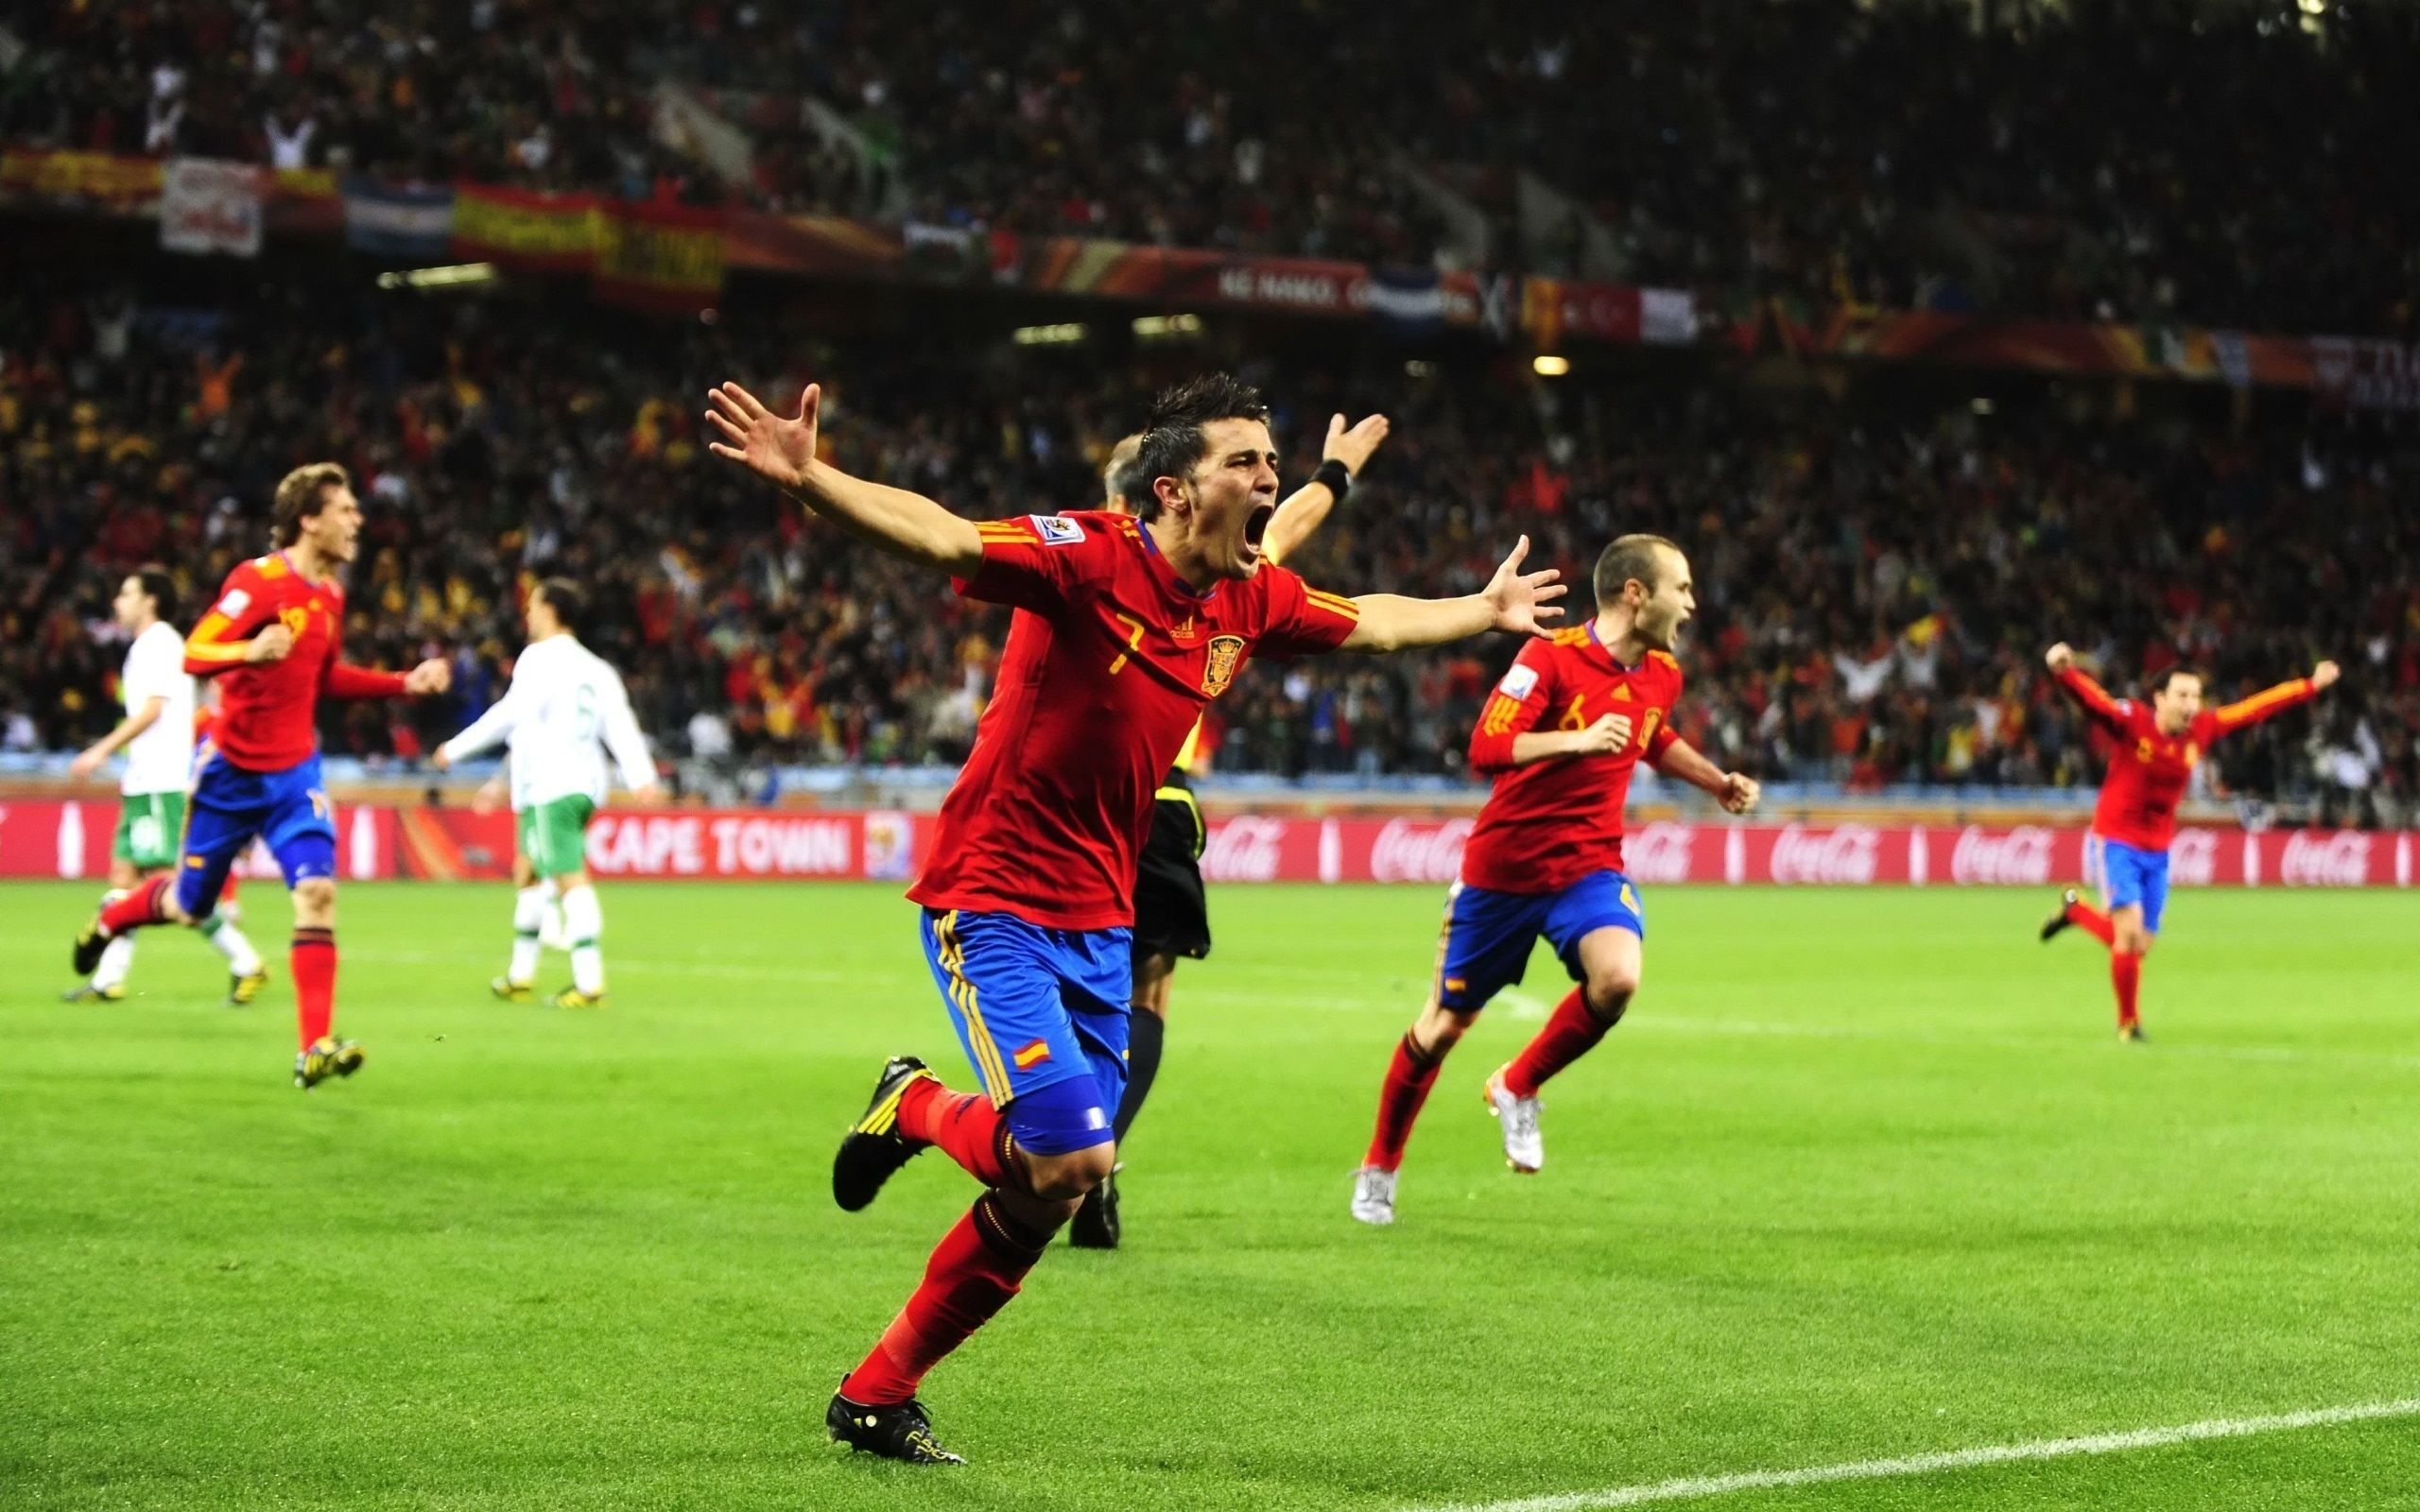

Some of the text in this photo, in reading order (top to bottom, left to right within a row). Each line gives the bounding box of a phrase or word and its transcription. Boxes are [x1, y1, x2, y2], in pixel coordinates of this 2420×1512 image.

[1108, 612, 1145, 676] 7
[1558, 694, 1585, 731] 6
[584, 816, 851, 874] CAPE TOWN
